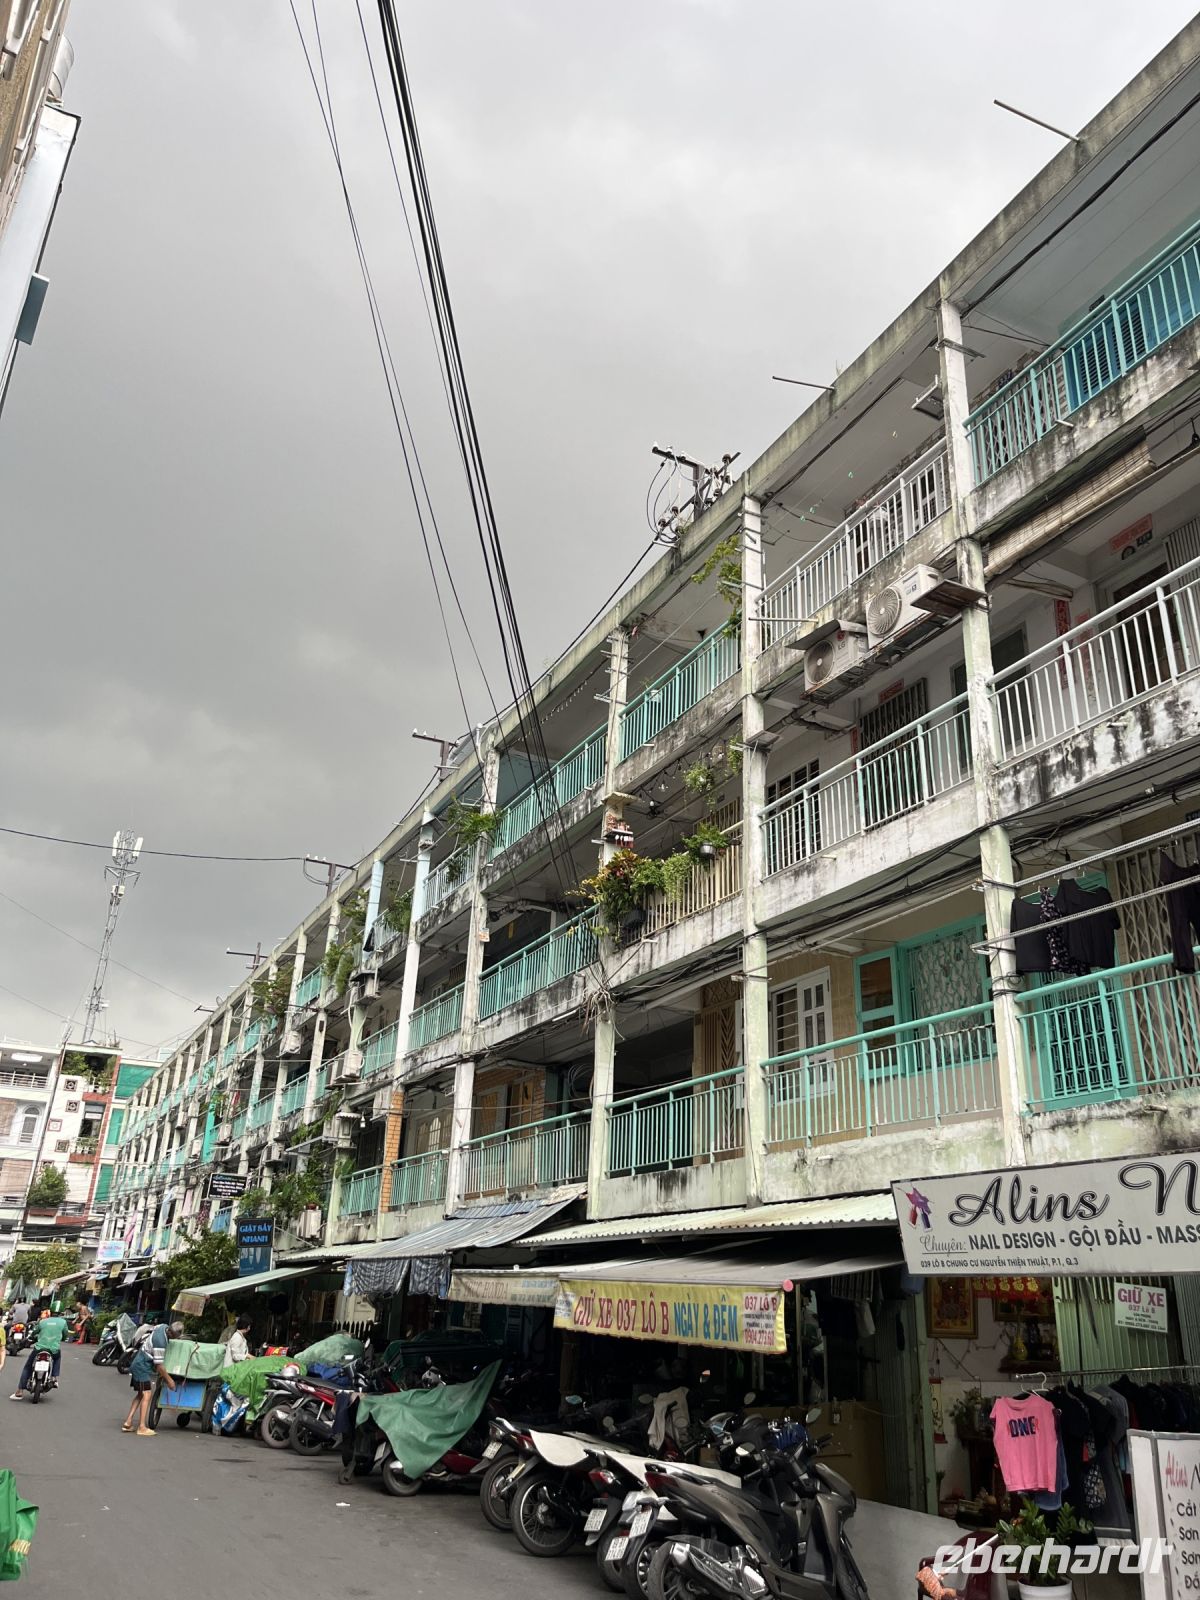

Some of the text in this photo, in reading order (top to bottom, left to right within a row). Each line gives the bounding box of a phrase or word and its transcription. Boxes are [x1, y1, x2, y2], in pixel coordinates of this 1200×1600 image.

[948, 1173, 1110, 1227] Alins
[968, 1234, 1000, 1251] NAIL
[1002, 1231, 1057, 1250] DESIGN
[1069, 1225, 1101, 1251] GỘI
[1104, 1219, 1141, 1246] ĐẦU
[946, 1258, 969, 1268] CHUNG
[745, 1296, 758, 1310] 037
[760, 1293, 769, 1311] LÔ
[1118, 1286, 1165, 1307] GIỮ XE
[596, 1298, 613, 1329] XE
[617, 1298, 637, 1331] 037
[641, 1291, 657, 1334] LÔ
[660, 1301, 669, 1335] B
[674, 1293, 699, 1338] NGÀY
[703, 1303, 711, 1340] &
[713, 1294, 739, 1342] ĐÊM
[1008, 1416, 1036, 1438] ONE
[1176, 1498, 1197, 1517] Cắt
[1179, 1526, 1200, 1541] Sơn
